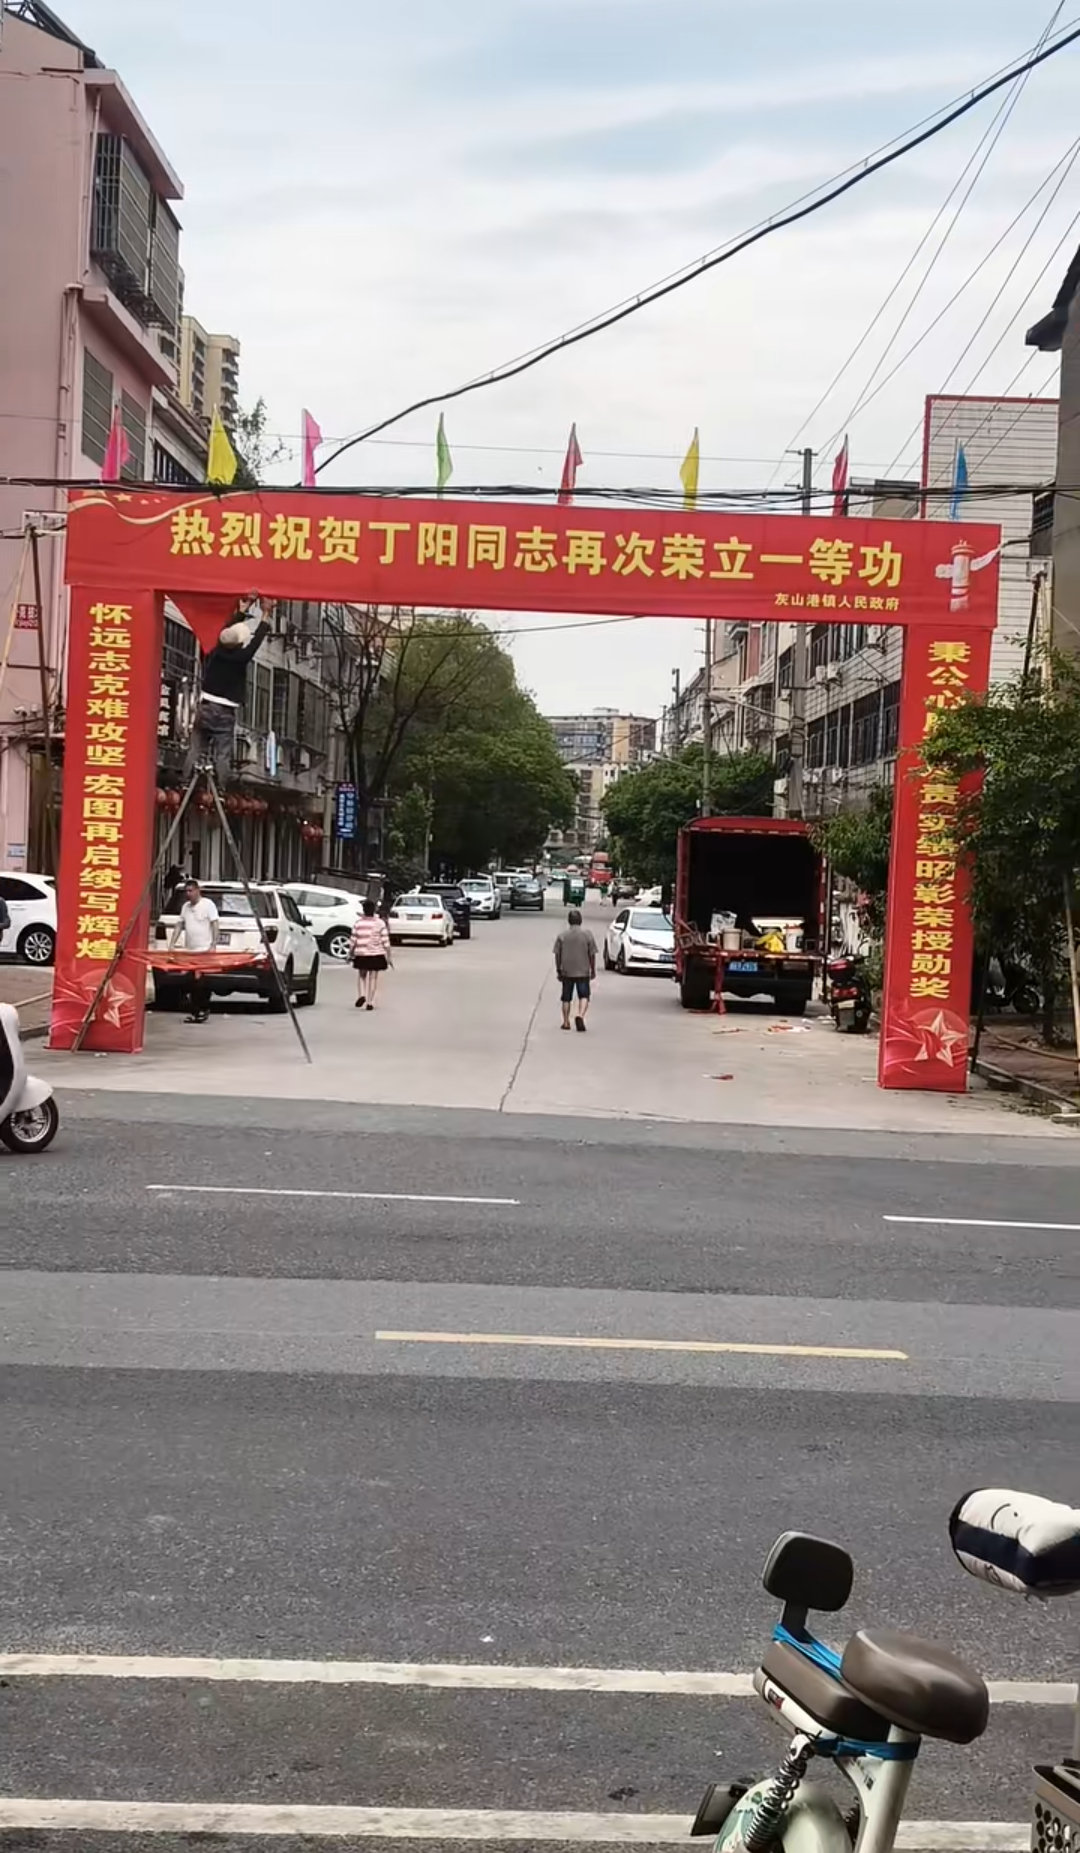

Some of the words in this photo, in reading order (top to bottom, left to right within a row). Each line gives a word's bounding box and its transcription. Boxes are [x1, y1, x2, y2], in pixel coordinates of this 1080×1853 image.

[170, 508, 904, 589] 热烈祝贺丁阳同志再次荣立一等功
[775, 592, 900, 612] 灰山港镇人民政府
